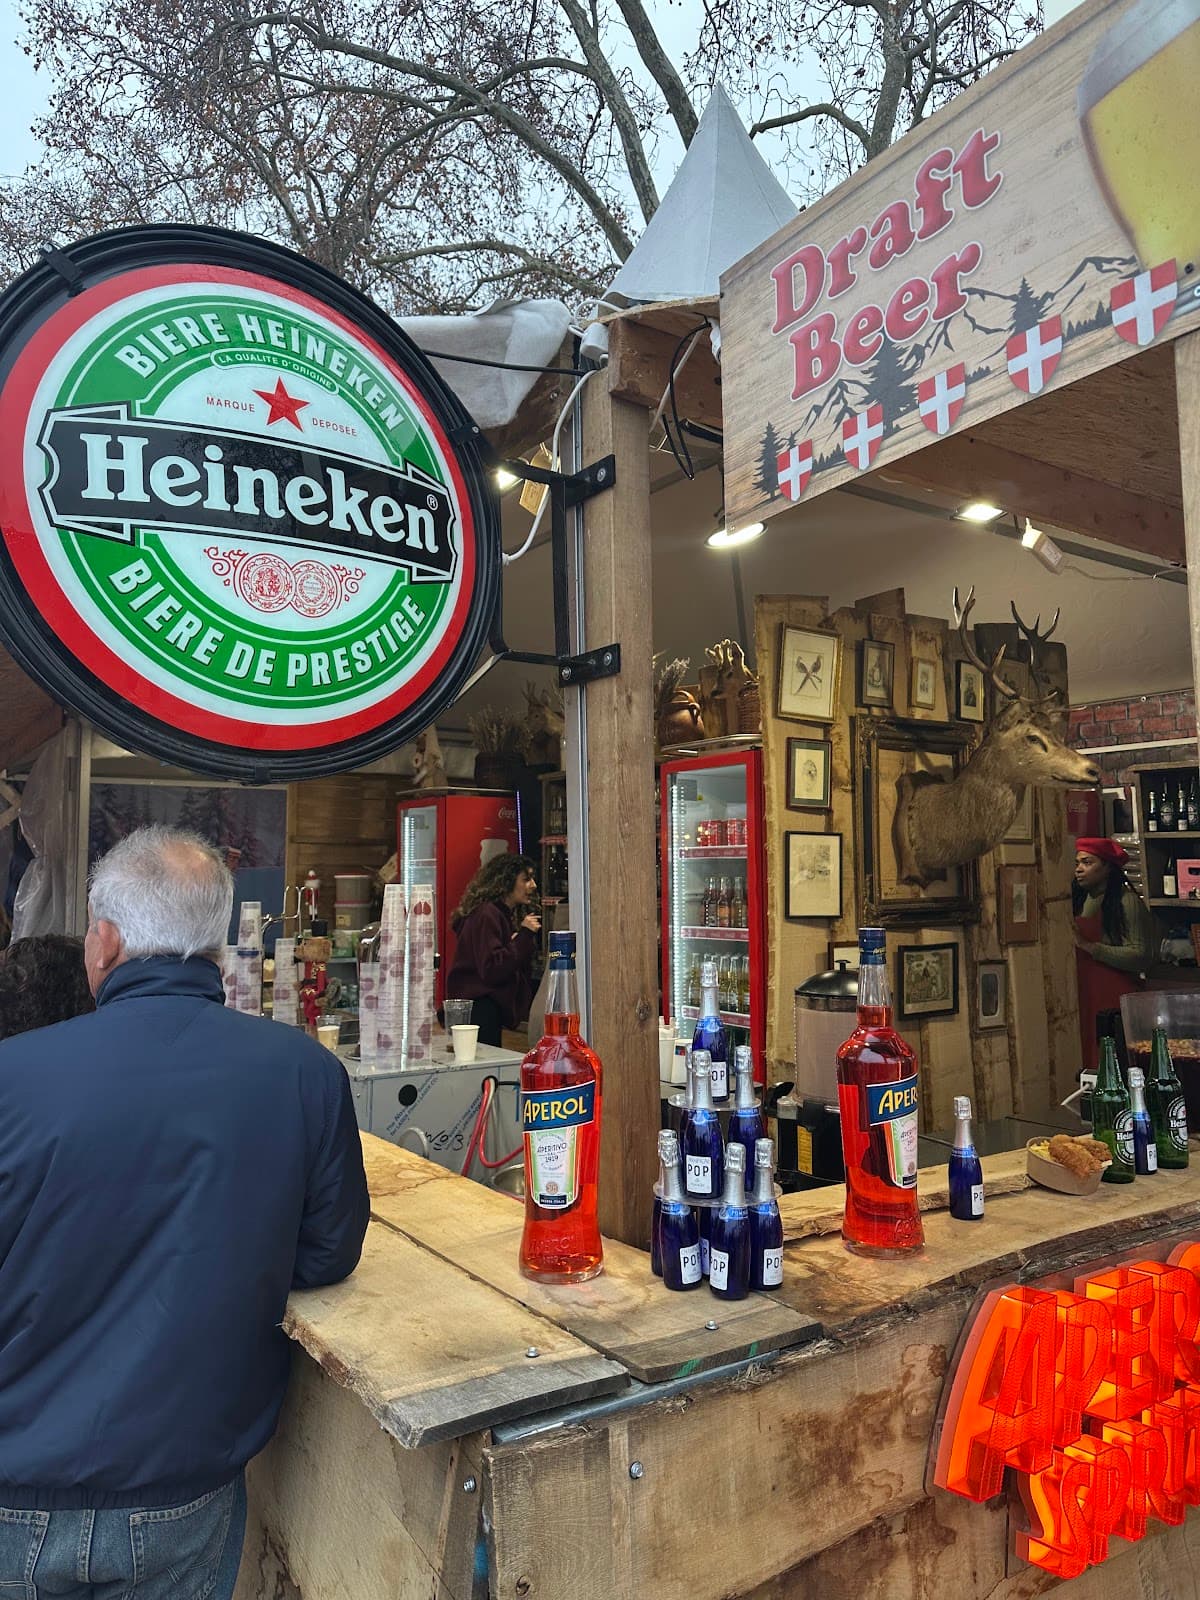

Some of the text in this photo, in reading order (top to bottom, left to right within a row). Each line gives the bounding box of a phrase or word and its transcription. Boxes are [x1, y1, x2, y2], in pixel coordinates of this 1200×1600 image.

[770, 128, 1003, 336] Draft
[789, 241, 983, 401] Beer
[218, 355, 232, 364] LA
[235, 353, 278, 364] QUALITE
[114, 313, 405, 432] BIERE HEINEKEN
[206, 396, 256, 413] MARQUE
[312, 417, 358, 437] DEPOSEE
[108, 558, 426, 688] BIERE DE PRESTIGE
[711, 1070, 726, 1082] OP
[522, 1095, 588, 1124] APEROL
[687, 1163, 709, 1177] POP
